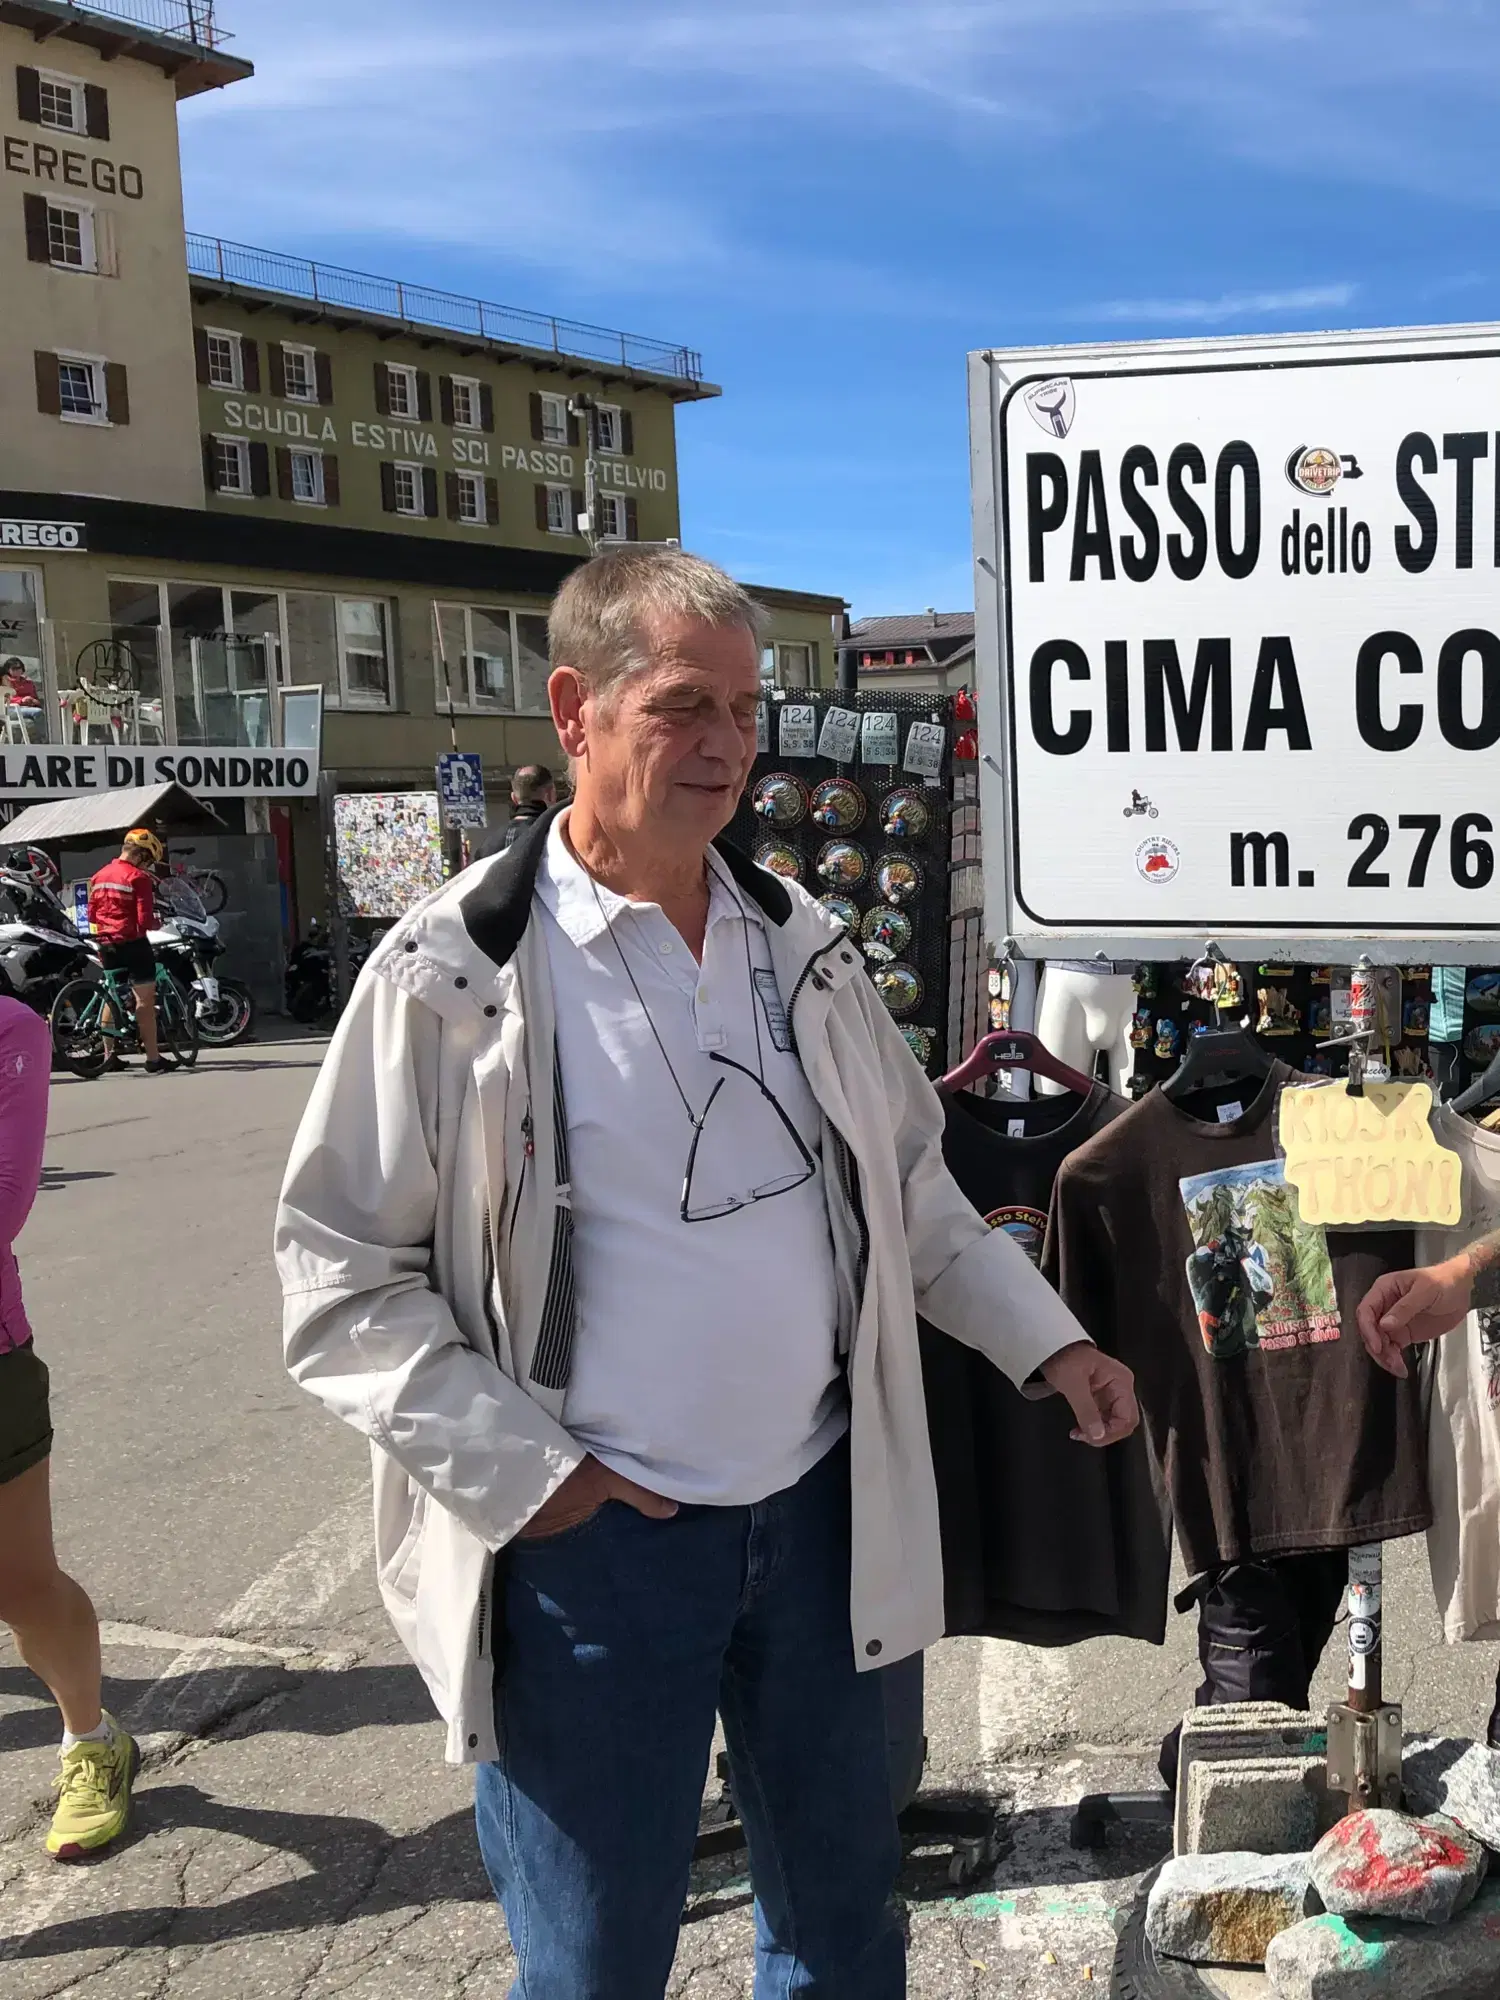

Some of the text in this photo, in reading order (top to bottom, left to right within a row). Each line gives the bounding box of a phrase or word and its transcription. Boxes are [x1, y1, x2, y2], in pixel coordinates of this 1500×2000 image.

[4, 135, 143, 200] EREGO
[224, 400, 337, 442] SCUOLA
[352, 421, 438, 457] ESTIVA
[451, 438, 489, 466] SCI
[502, 445, 573, 478] PASSO
[1299, 467, 1341, 477] DRIVETRIP
[1026, 431, 1500, 582] PASSO dello ST
[0, 523, 79, 547] REGO
[1029, 628, 1500, 755] CIMA CO
[783, 707, 812, 724] 124
[828, 709, 858, 731] 124
[865, 715, 894, 731] 124
[912, 725, 942, 744] 124
[0, 755, 309, 788] LARE DI SONDRIO
[1135, 836, 1181, 857] COUNTRY RIDERS
[1230, 812, 1494, 889] m. 276
[1284, 1091, 1425, 1144] KIOSK
[987, 1213, 1012, 1229] sso
